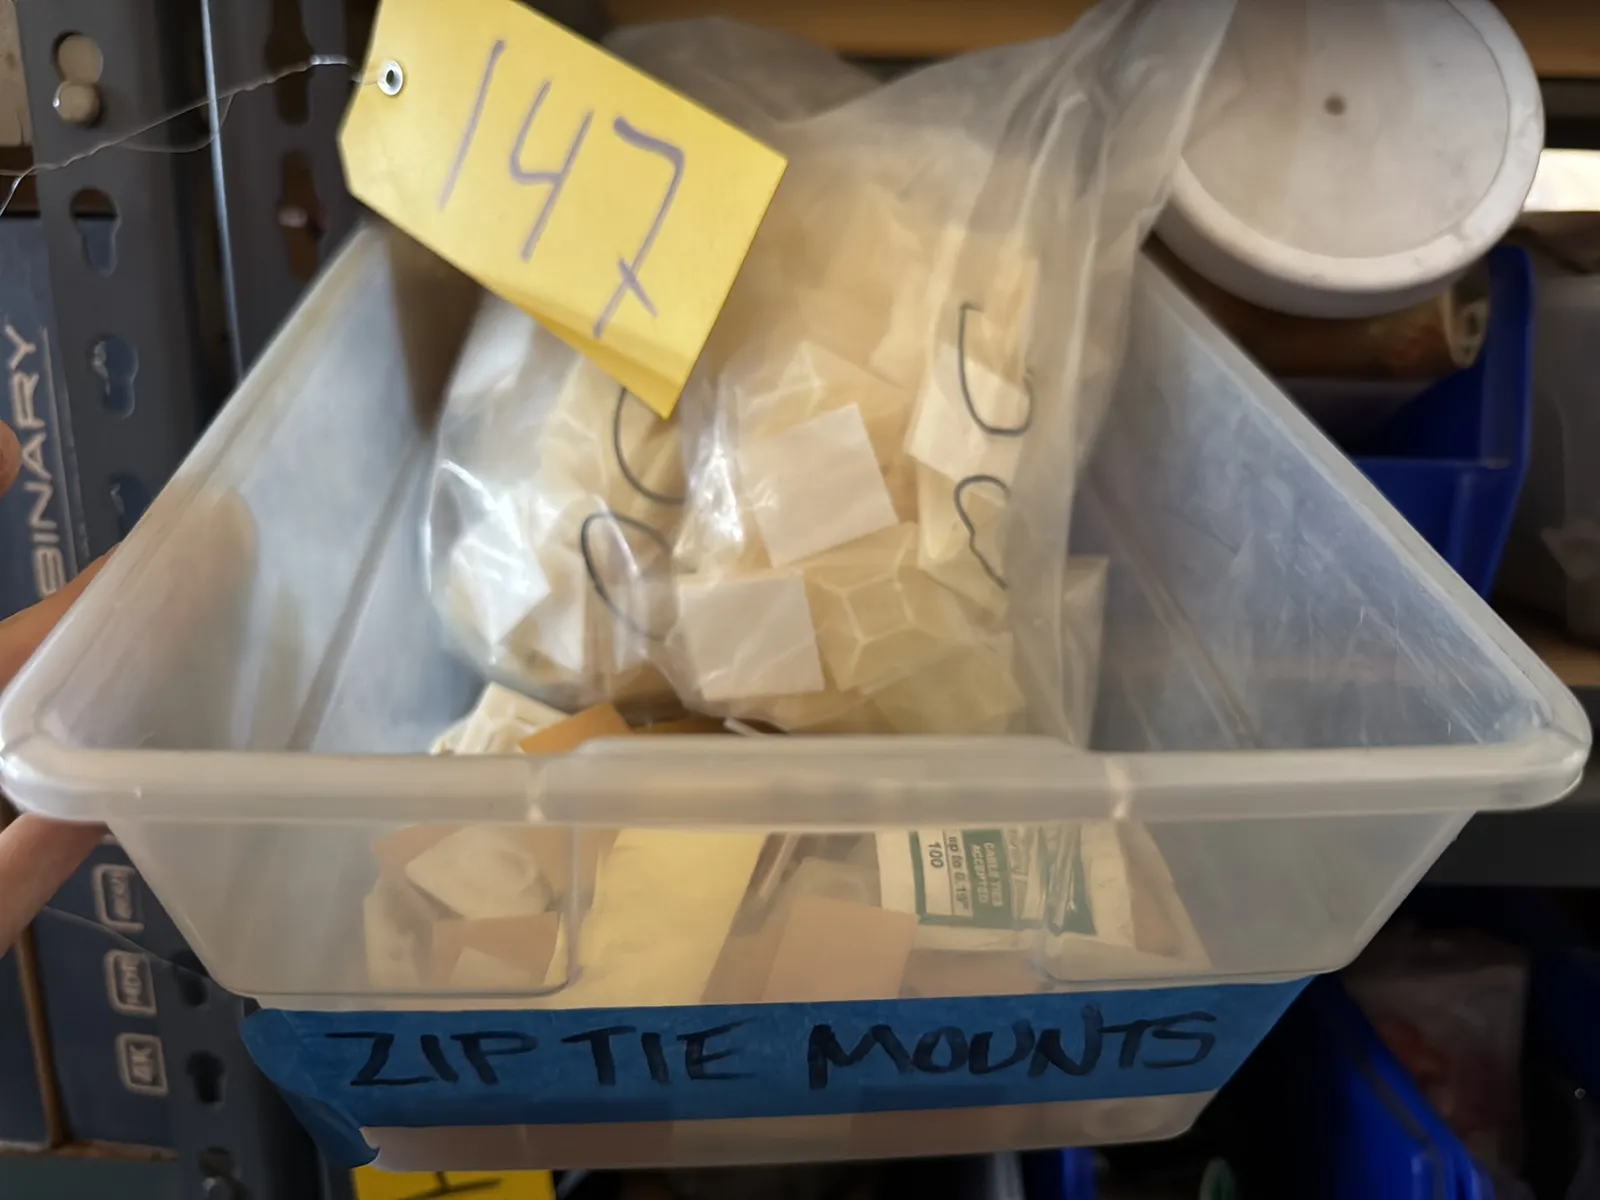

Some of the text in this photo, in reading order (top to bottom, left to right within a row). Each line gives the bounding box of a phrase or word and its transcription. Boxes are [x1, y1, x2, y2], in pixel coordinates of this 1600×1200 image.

[437, 38, 686, 340] 147
[4, 323, 67, 600] BINARY
[928, 842, 944, 868] 100
[947, 836, 959, 852] up
[951, 855, 963, 869] to
[325, 1003, 1217, 1090] ZIP TIE MOUNTS
